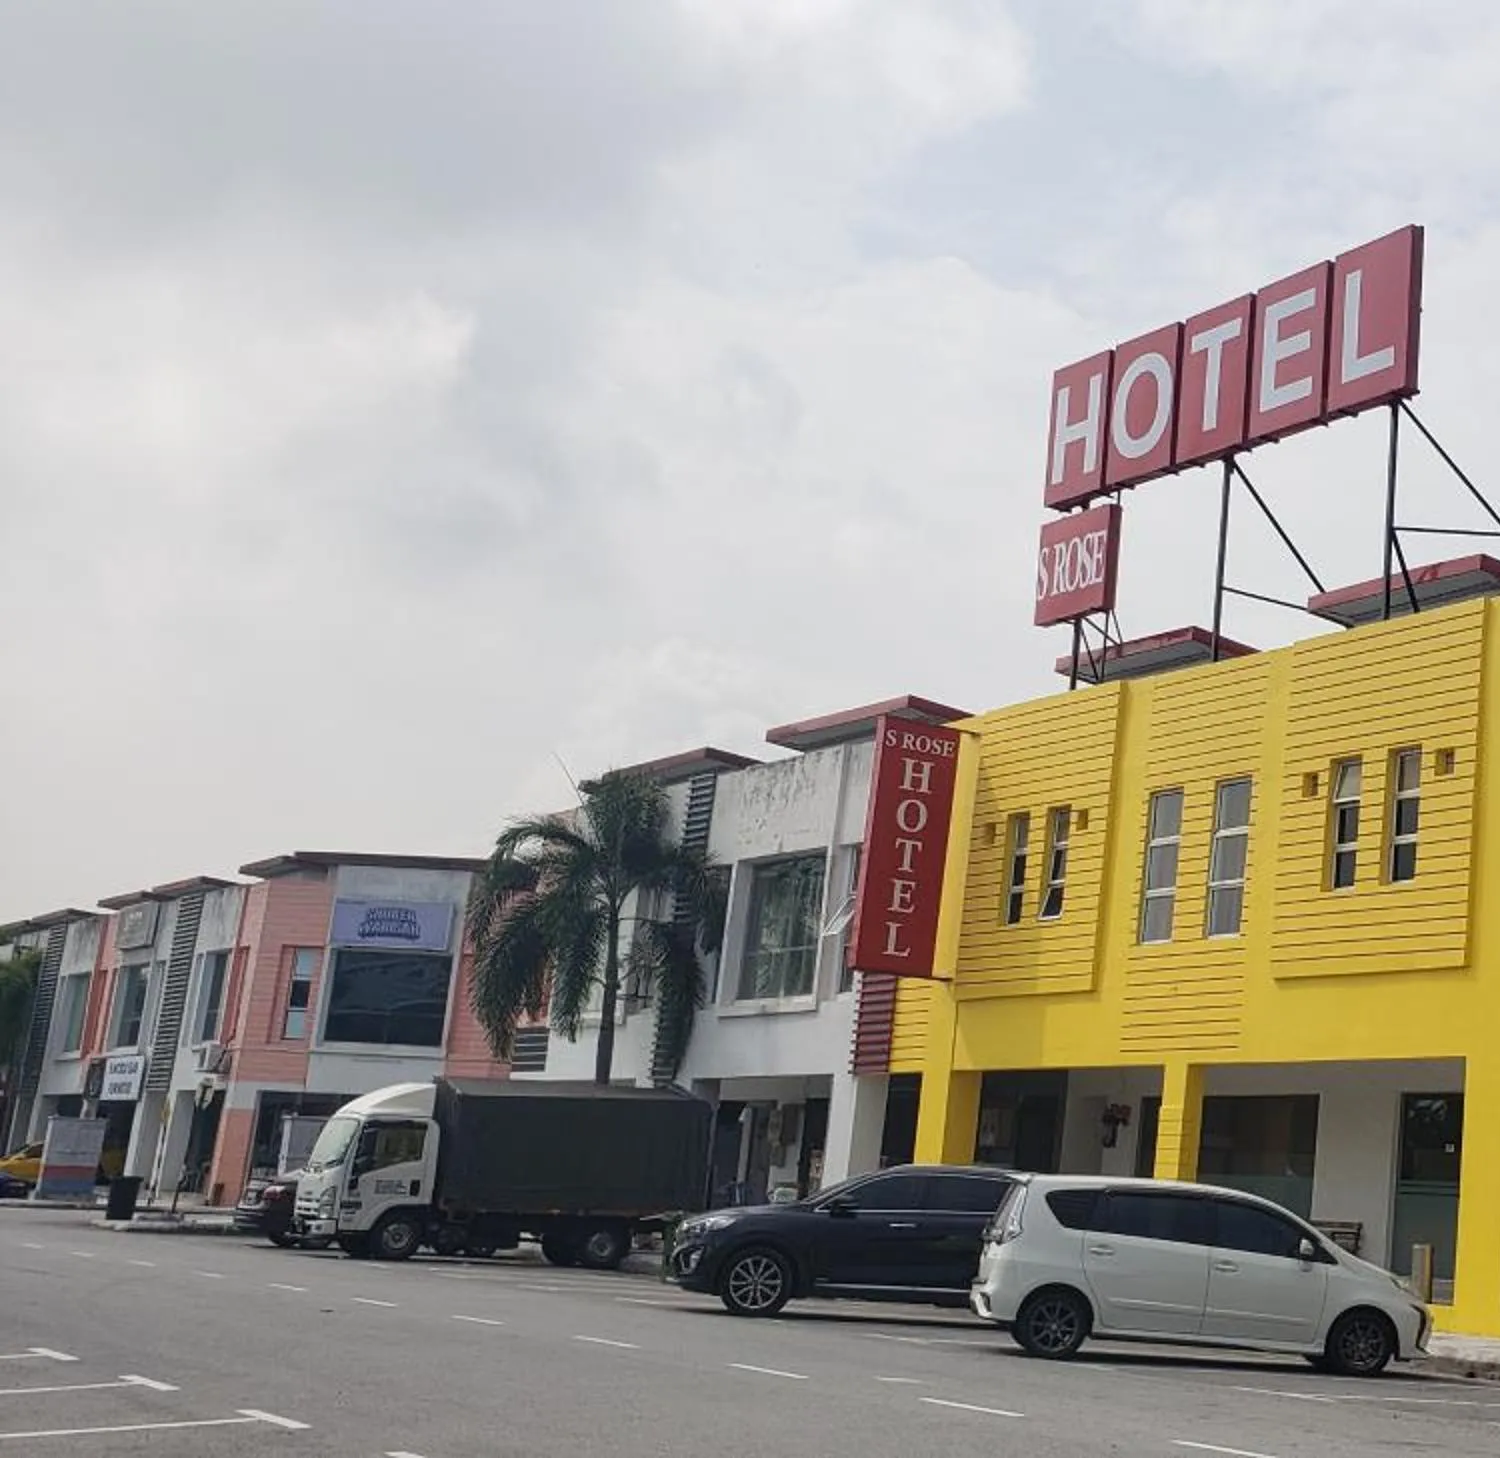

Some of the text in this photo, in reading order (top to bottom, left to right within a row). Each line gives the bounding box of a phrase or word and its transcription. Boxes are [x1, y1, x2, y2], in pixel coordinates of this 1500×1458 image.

[1051, 270, 1396, 485] HOTEL
[1036, 529, 1107, 601] S ROSE
[885, 729, 955, 758] S ROSE
[881, 757, 935, 958] HOTEL
